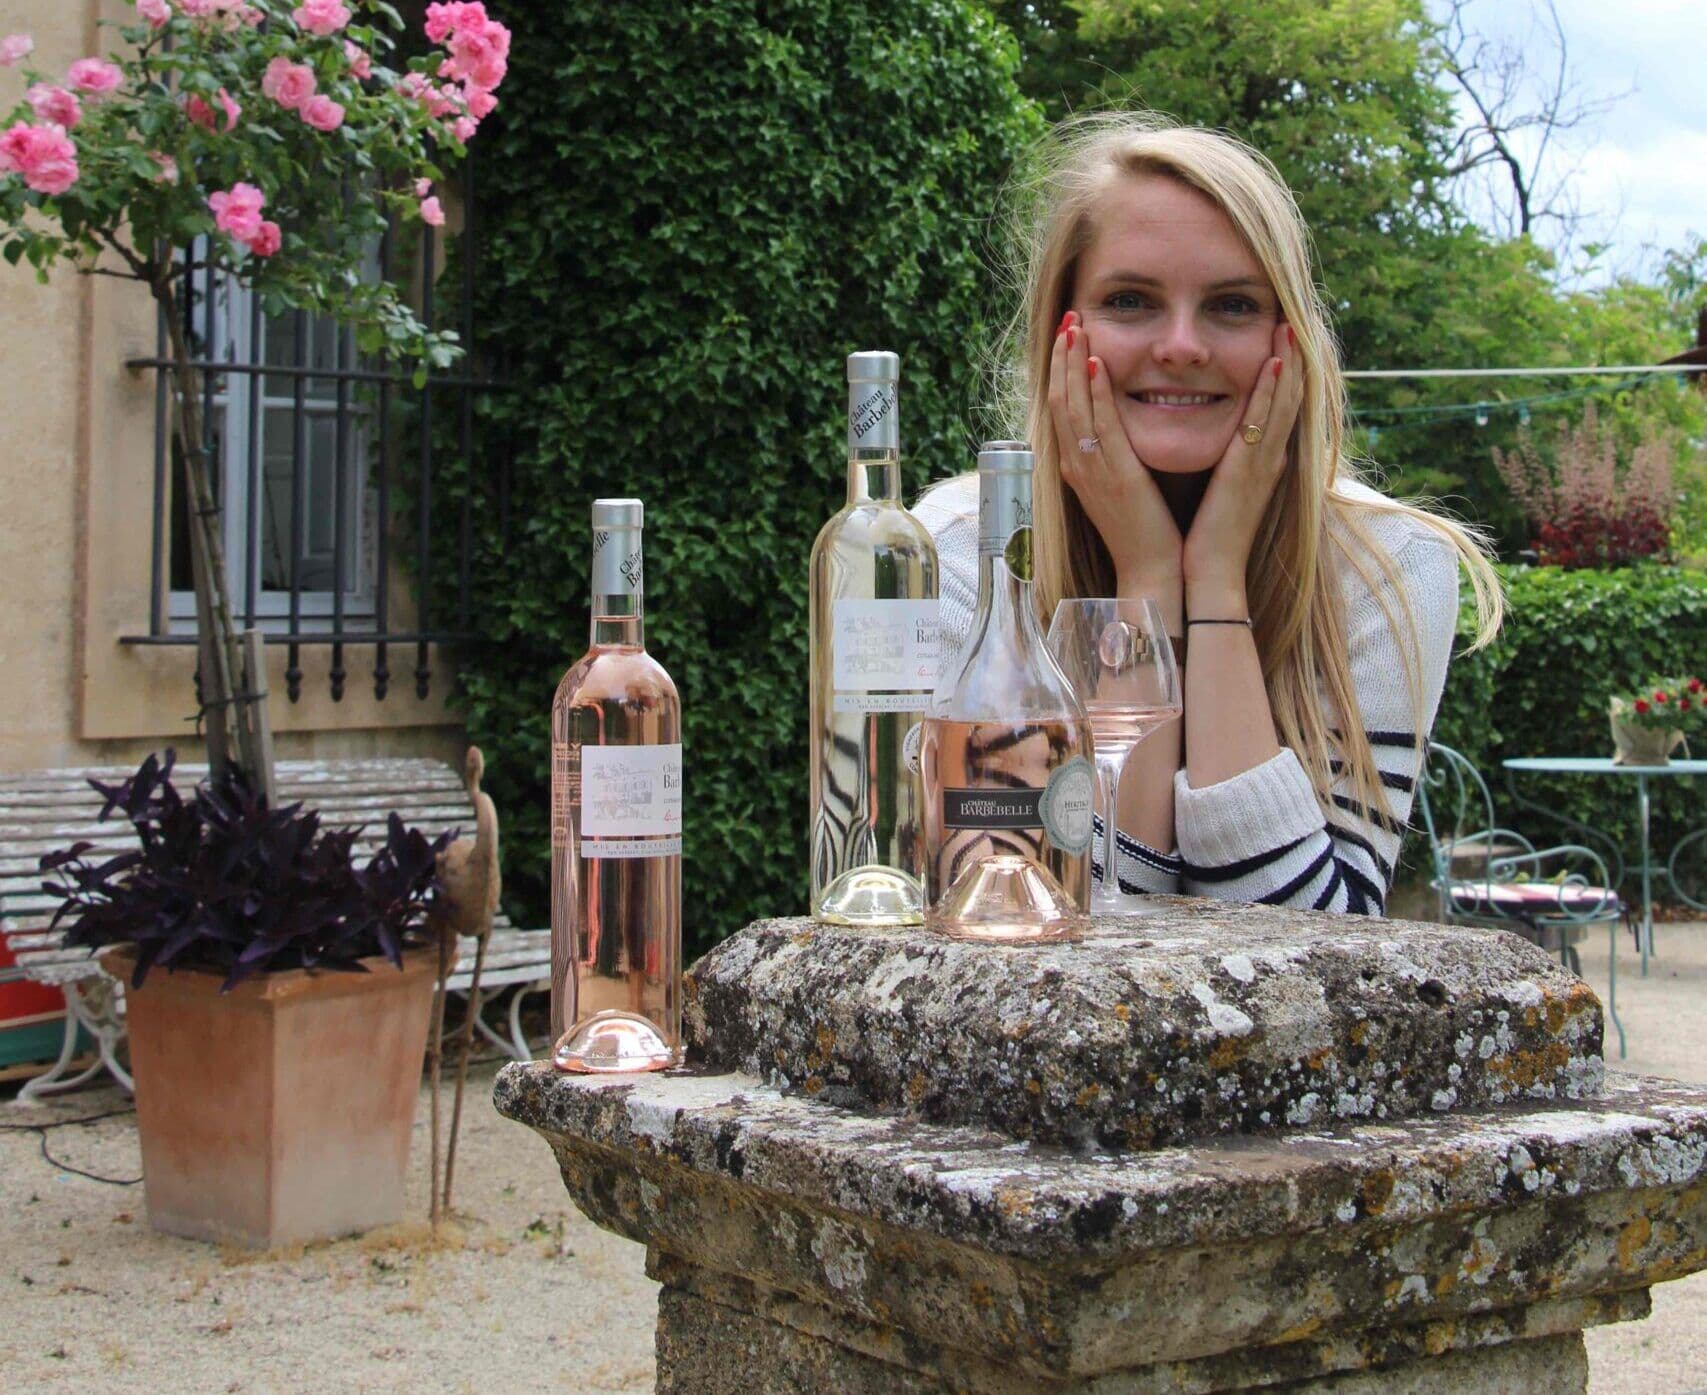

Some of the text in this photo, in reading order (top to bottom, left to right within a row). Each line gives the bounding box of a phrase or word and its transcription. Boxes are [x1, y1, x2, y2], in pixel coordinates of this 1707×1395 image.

[850, 389, 883, 426] Château
[626, 567, 641, 588] Ba
[960, 802, 1033, 817] BARBEBELLE
